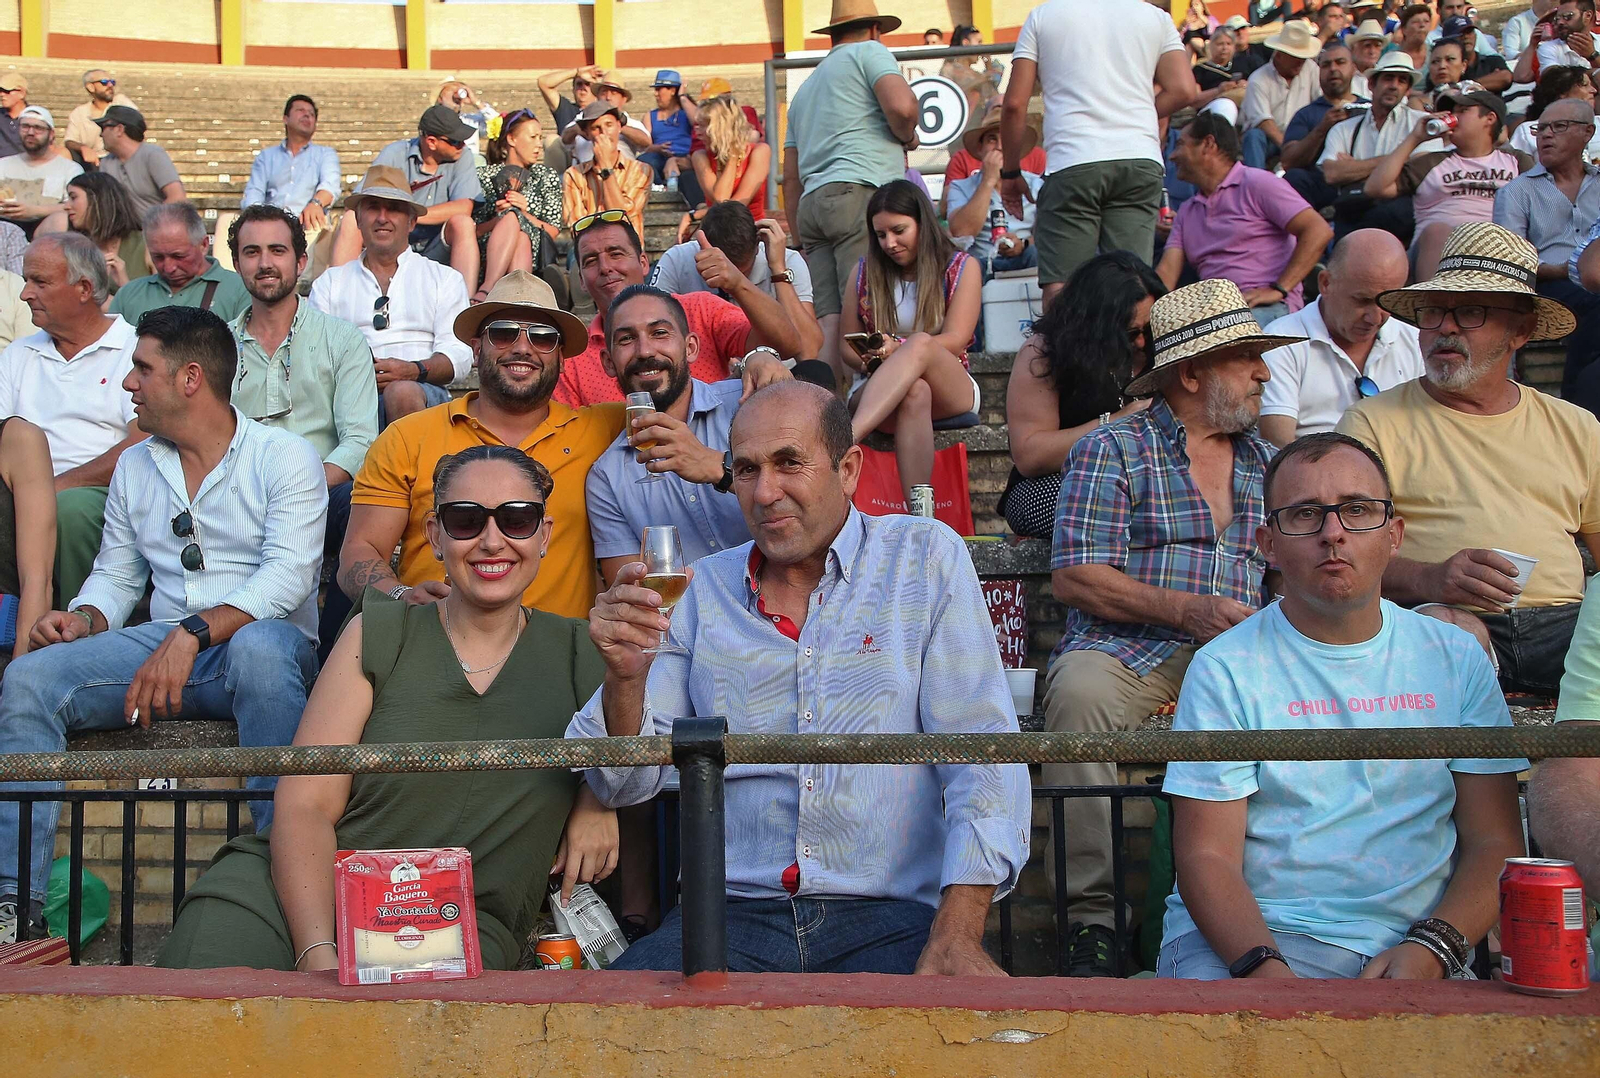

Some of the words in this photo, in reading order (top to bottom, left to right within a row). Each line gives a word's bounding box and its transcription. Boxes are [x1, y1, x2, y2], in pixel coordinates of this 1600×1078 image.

[918, 90, 944, 134] 6
[1442, 168, 1514, 184] OKAYAMA
[872, 499, 901, 509] ALVARO
[1288, 698, 1342, 716] CHILL
[1348, 696, 1386, 713] OUT
[1389, 693, 1436, 711] VIBES
[392, 883, 421, 893] García
[383, 890, 428, 903] Baquero
[376, 906, 393, 917] Ya
[393, 904, 439, 917] Cortado
